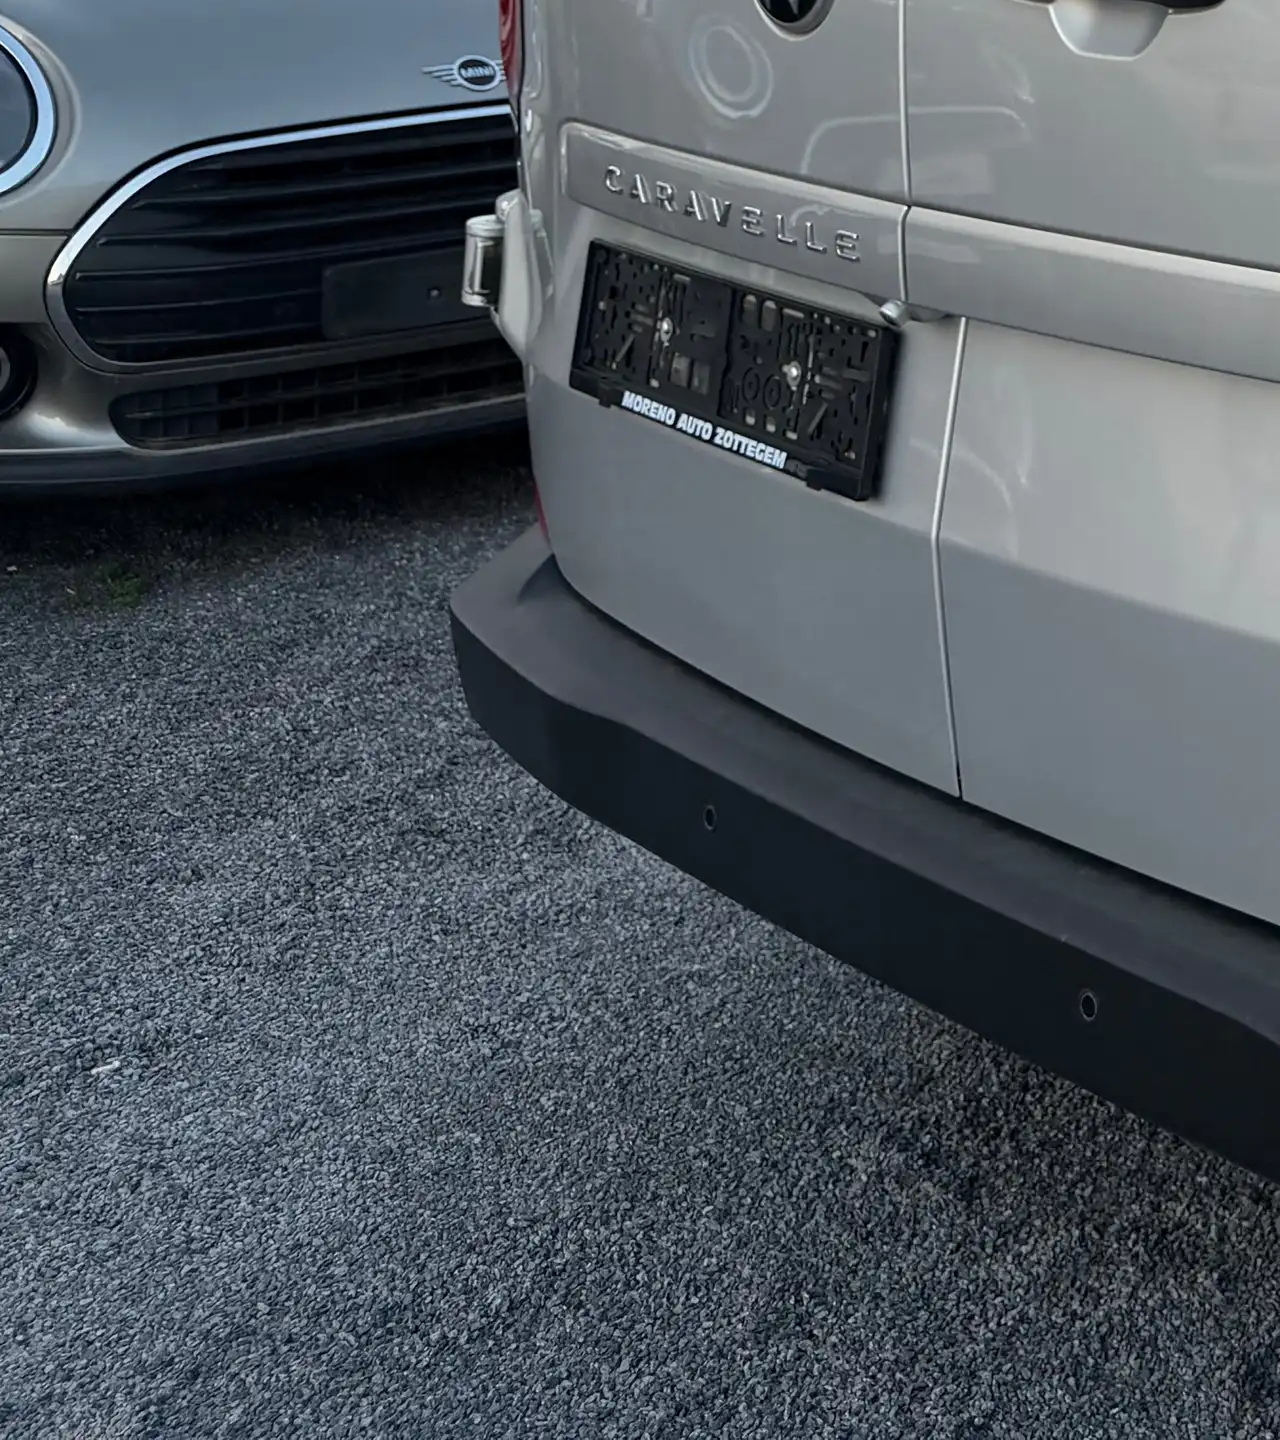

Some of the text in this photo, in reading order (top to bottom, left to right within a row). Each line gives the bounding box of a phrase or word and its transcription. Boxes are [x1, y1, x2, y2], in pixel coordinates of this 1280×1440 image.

[604, 165, 861, 262] CARAVELLE
[621, 390, 788, 469] MORENO AUTO ZOTTEGEM
